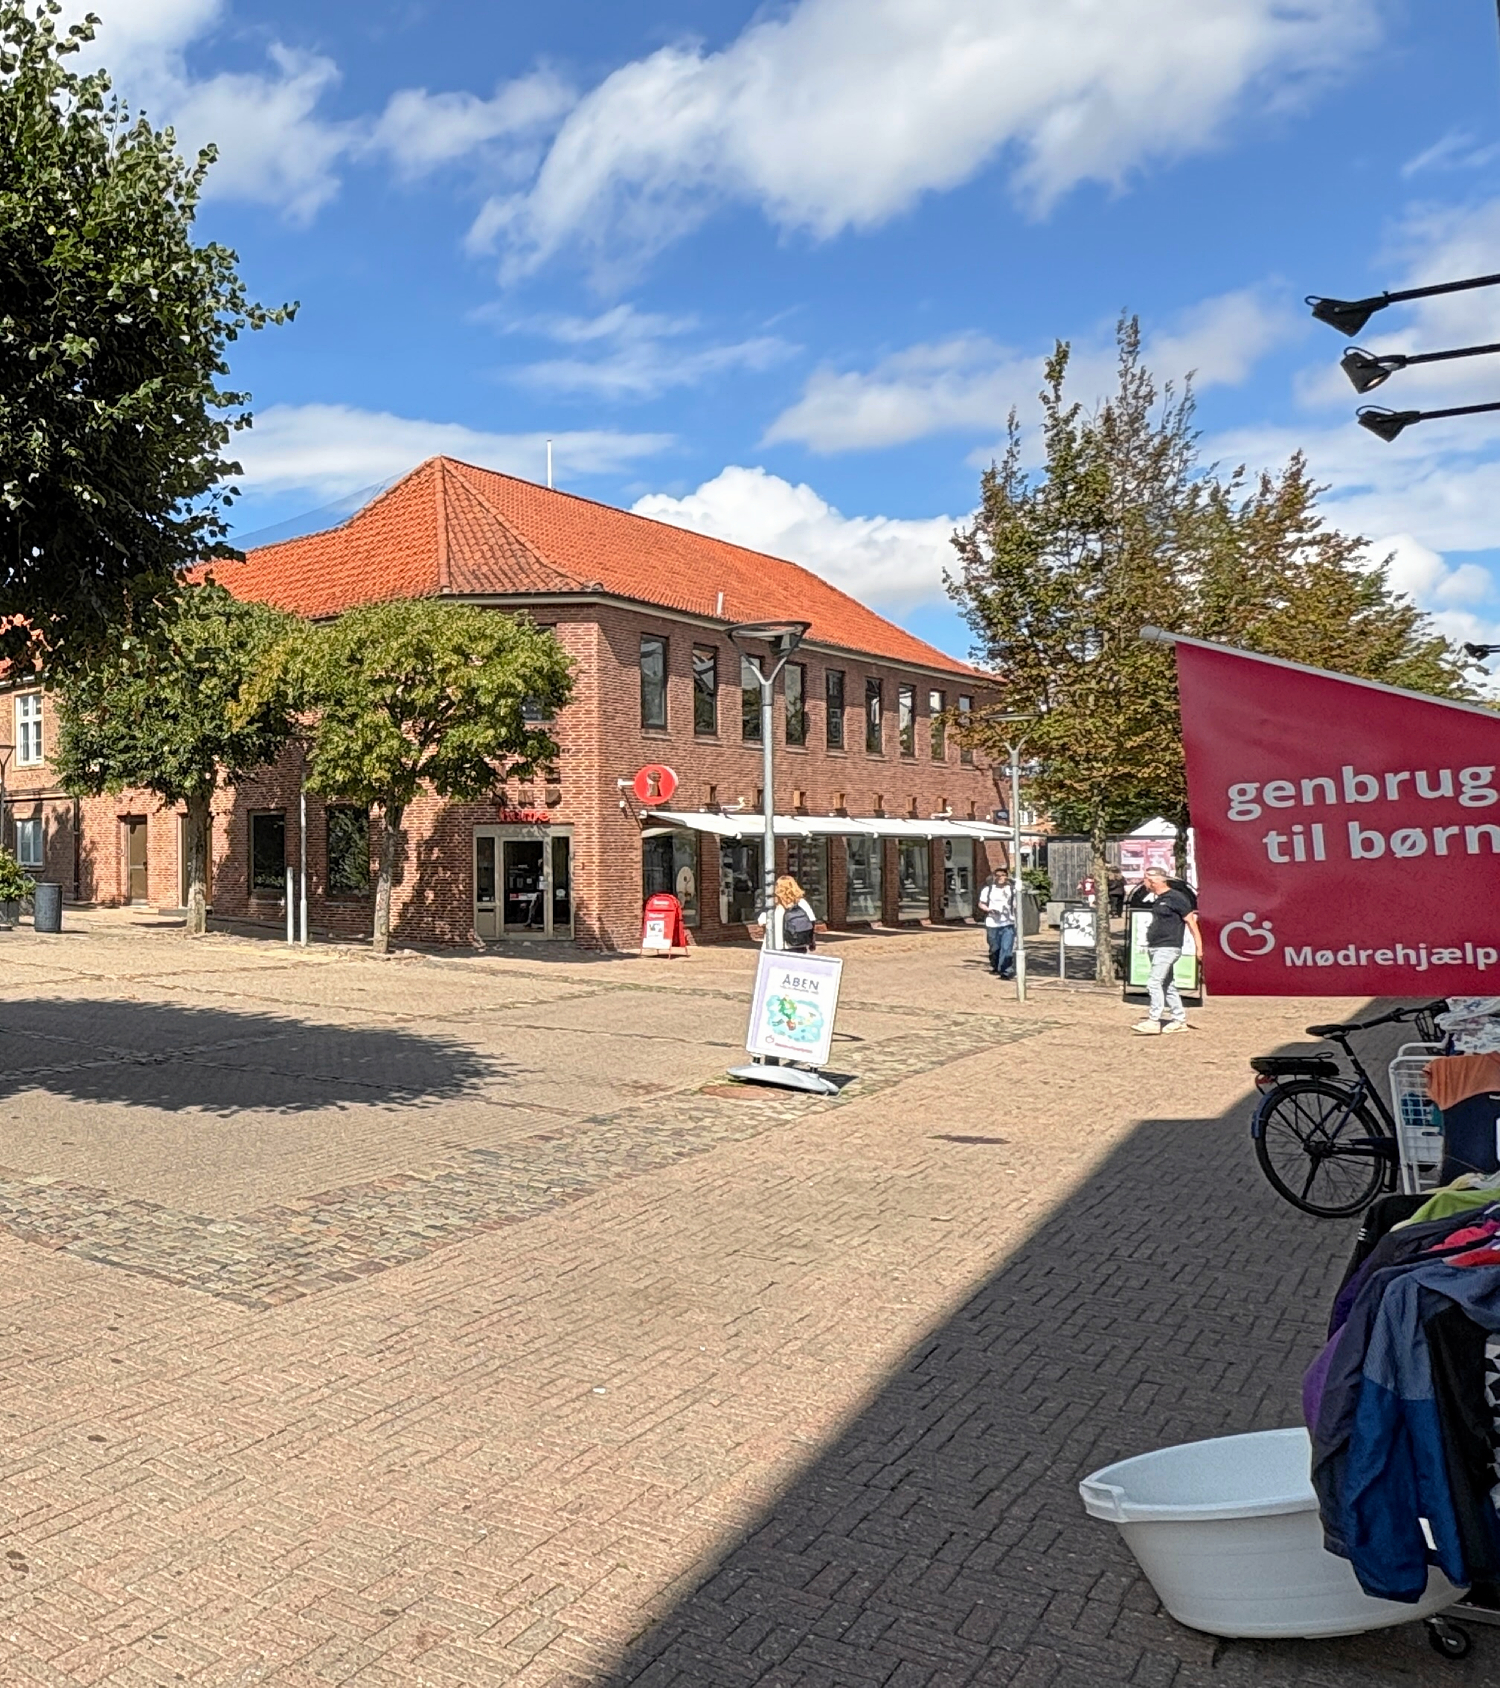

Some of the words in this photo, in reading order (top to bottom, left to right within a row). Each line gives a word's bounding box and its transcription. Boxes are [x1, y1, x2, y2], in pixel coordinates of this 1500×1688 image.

[1227, 765, 1499, 822] genbrug
[1262, 823, 1327, 863] til
[1348, 821, 1500, 860] børn
[1284, 942, 1498, 972] Mødrehjælp
[782, 973, 819, 991] ÅBEN
